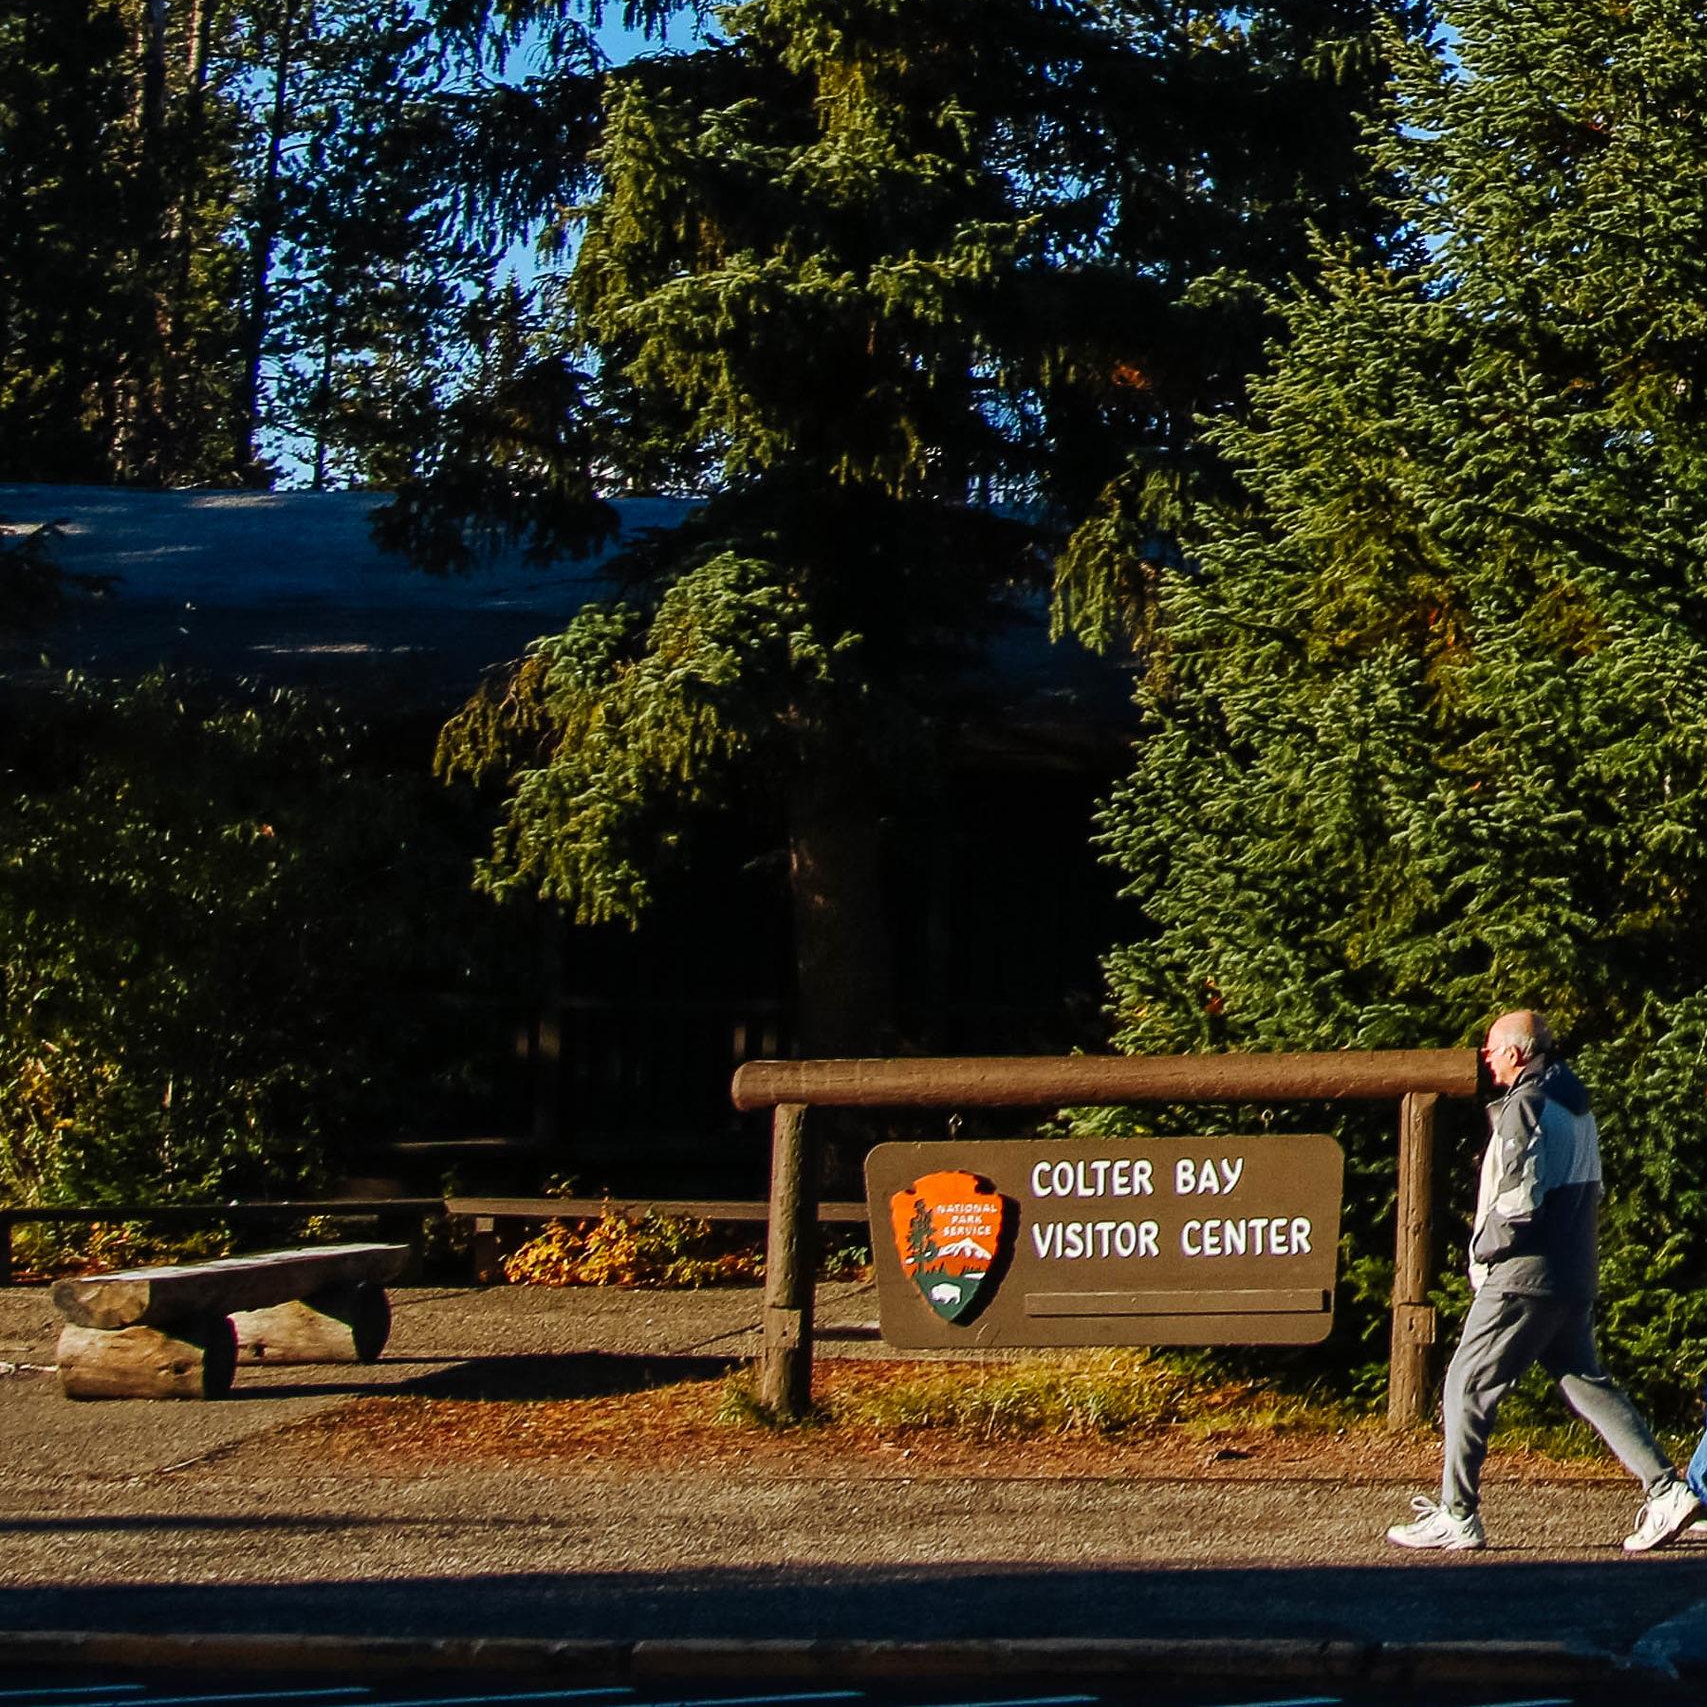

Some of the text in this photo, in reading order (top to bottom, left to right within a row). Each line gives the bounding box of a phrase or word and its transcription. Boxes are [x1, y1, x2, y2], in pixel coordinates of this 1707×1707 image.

[1030, 1157, 1244, 1197] COLTER BAY
[936, 1203, 998, 1214] NATIONAL
[951, 1215, 983, 1224] PARK
[943, 1225, 992, 1237] SERVICE
[1030, 1216, 1312, 1260] VISITOR CENTER
